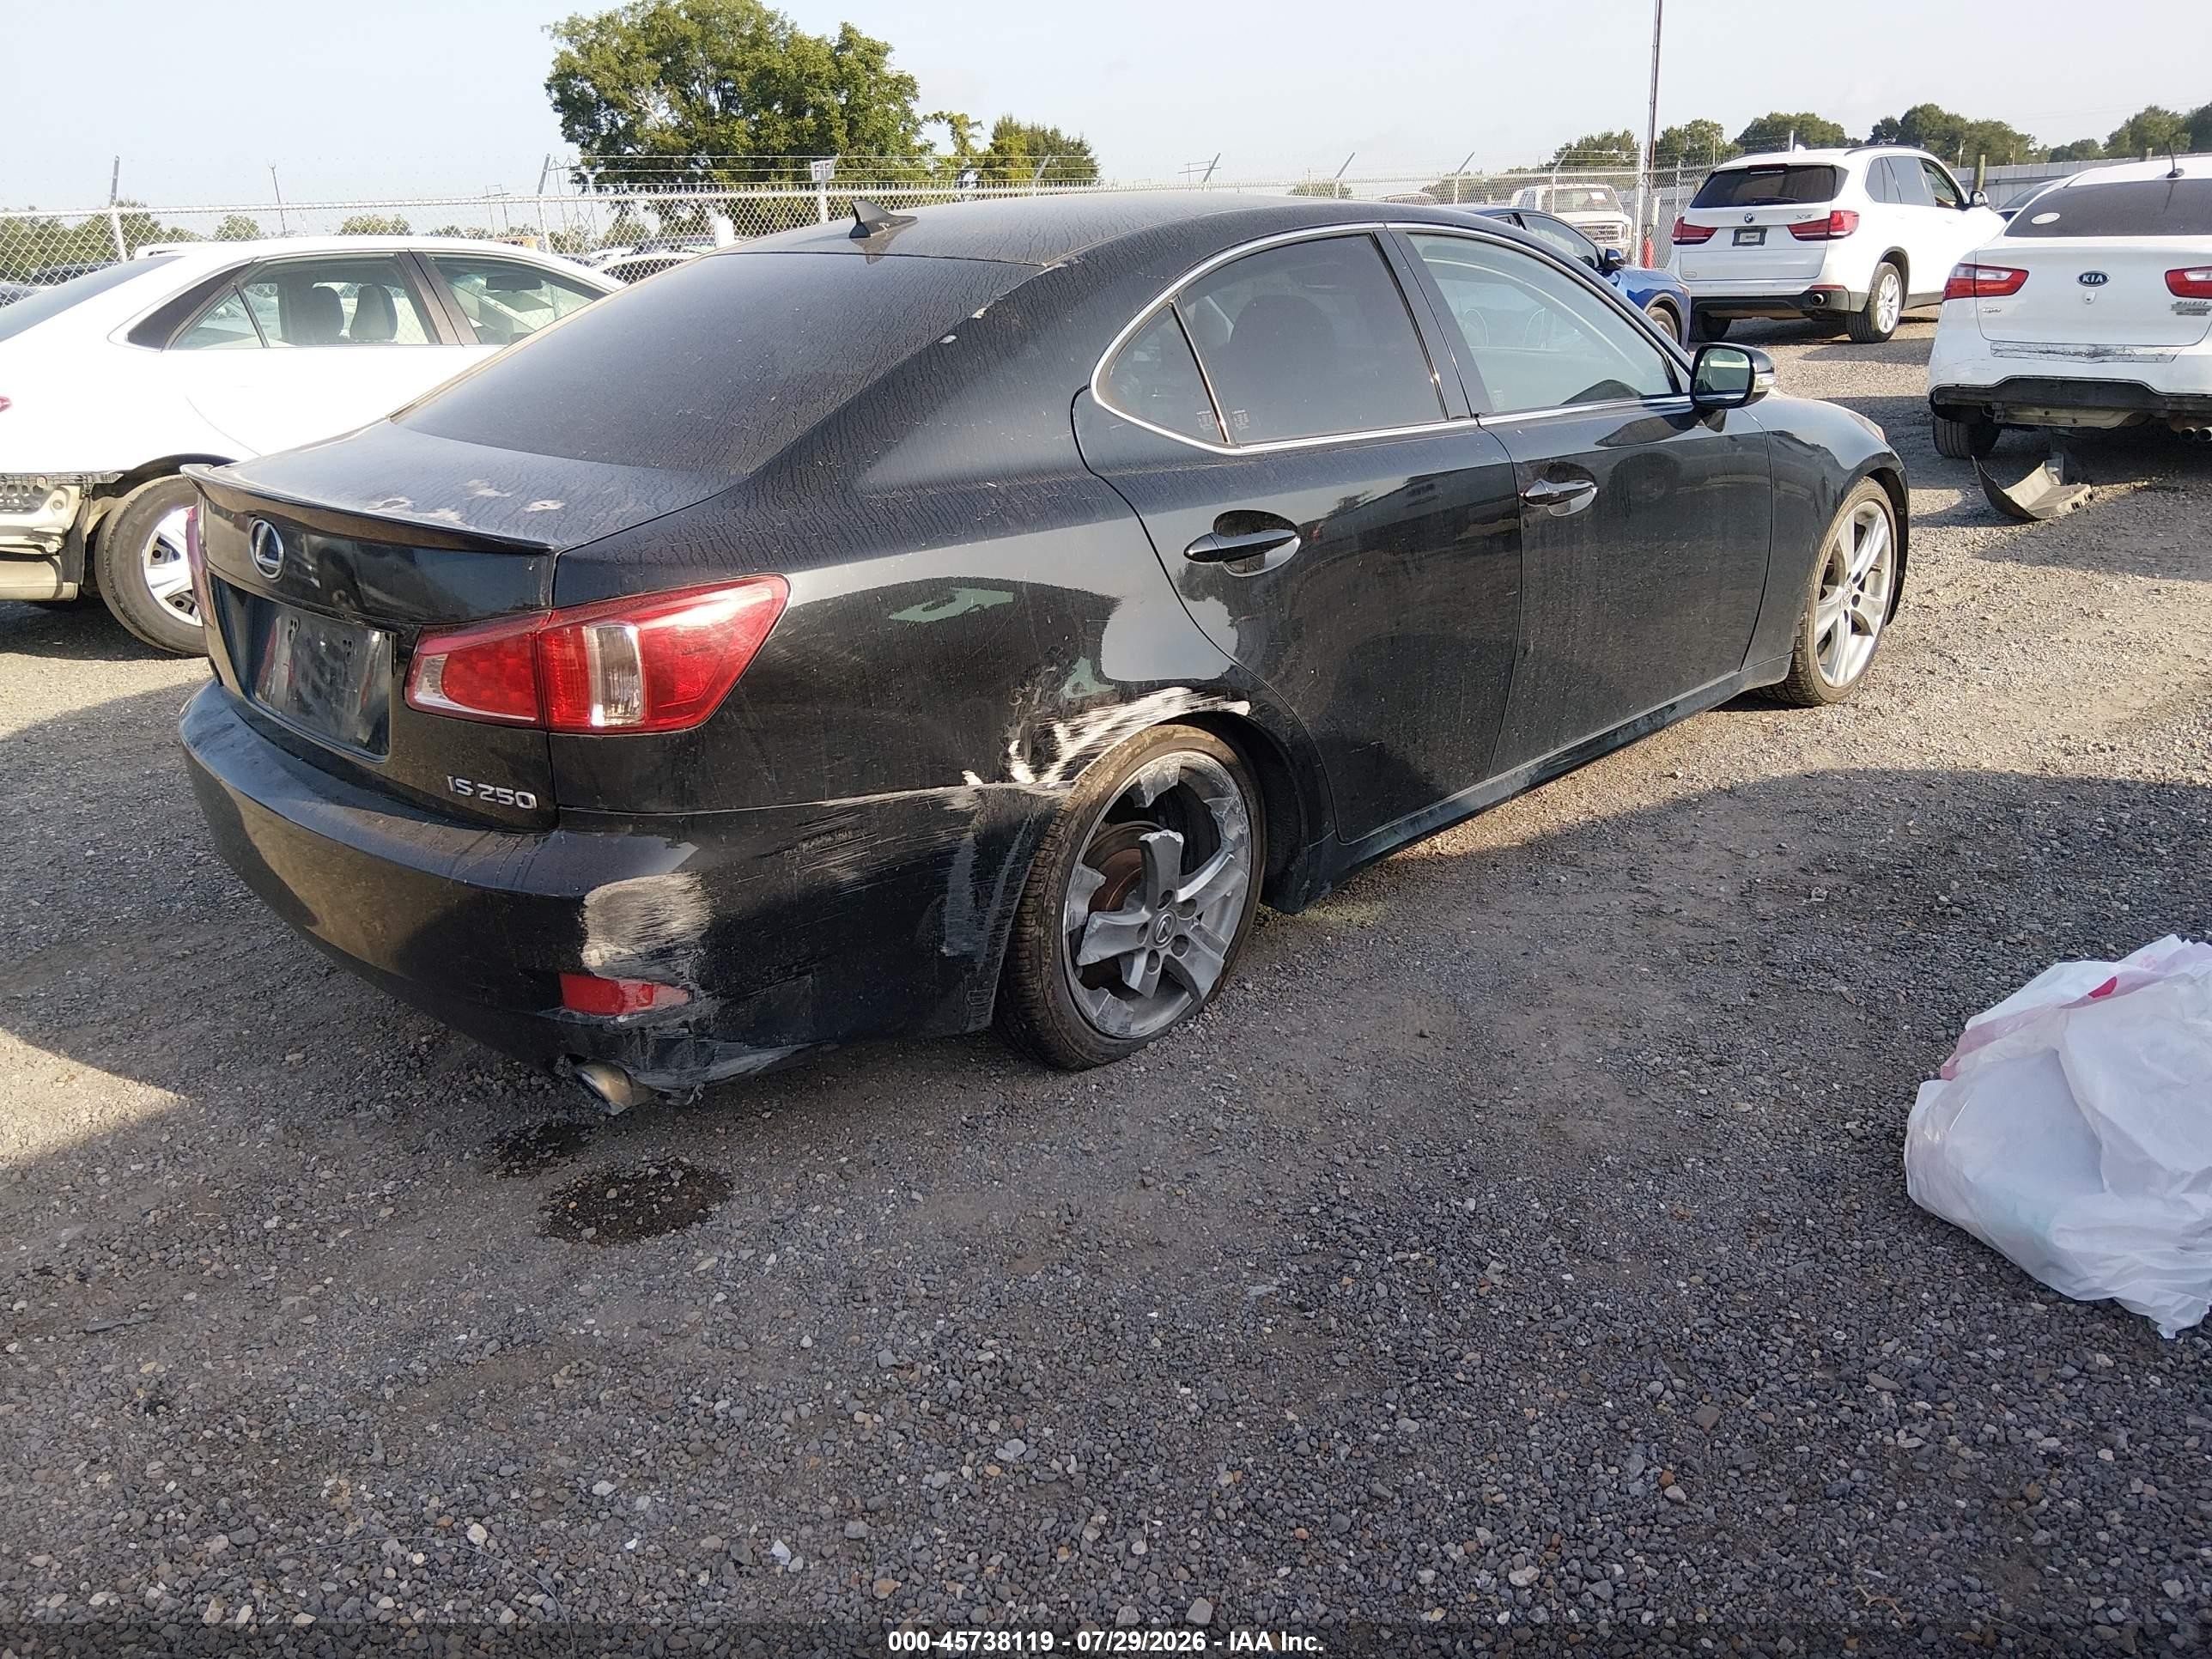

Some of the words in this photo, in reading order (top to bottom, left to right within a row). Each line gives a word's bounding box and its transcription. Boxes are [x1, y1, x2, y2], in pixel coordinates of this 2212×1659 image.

[2081, 274, 2104, 283] KIA
[447, 775, 474, 797] IS
[477, 782, 538, 810] 250
